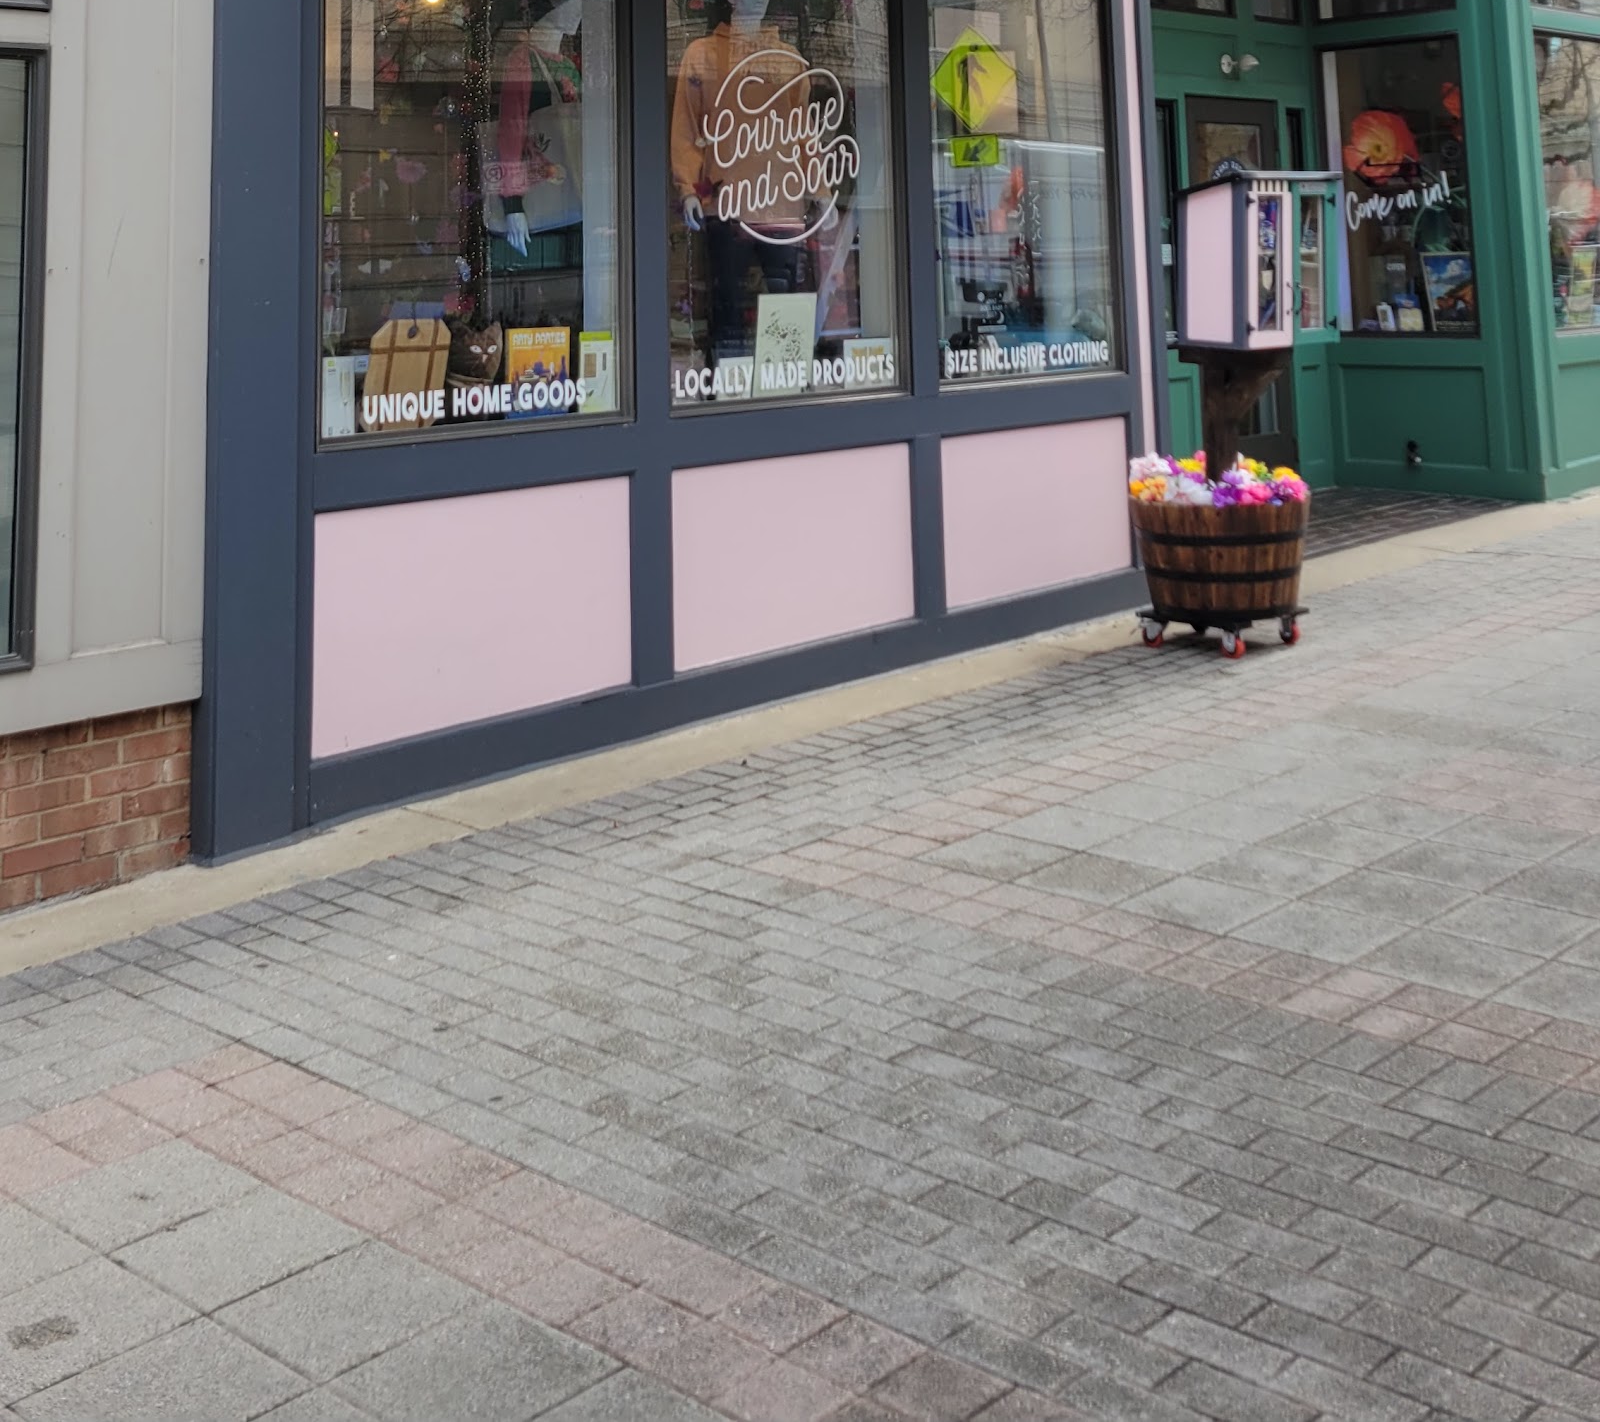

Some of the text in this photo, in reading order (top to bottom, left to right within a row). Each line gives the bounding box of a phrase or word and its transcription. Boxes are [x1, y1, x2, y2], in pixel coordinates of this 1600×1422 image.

[702, 88, 844, 169] Courage
[717, 135, 860, 221] and Soar
[1346, 170, 1452, 231] Come on in!
[675, 354, 894, 398] LOCALLY MADE PRODUCTS
[947, 340, 1109, 373] SIZE INCLUSIVE CLOTHING
[363, 378, 587, 425] UNIQUE HOME GOODS
